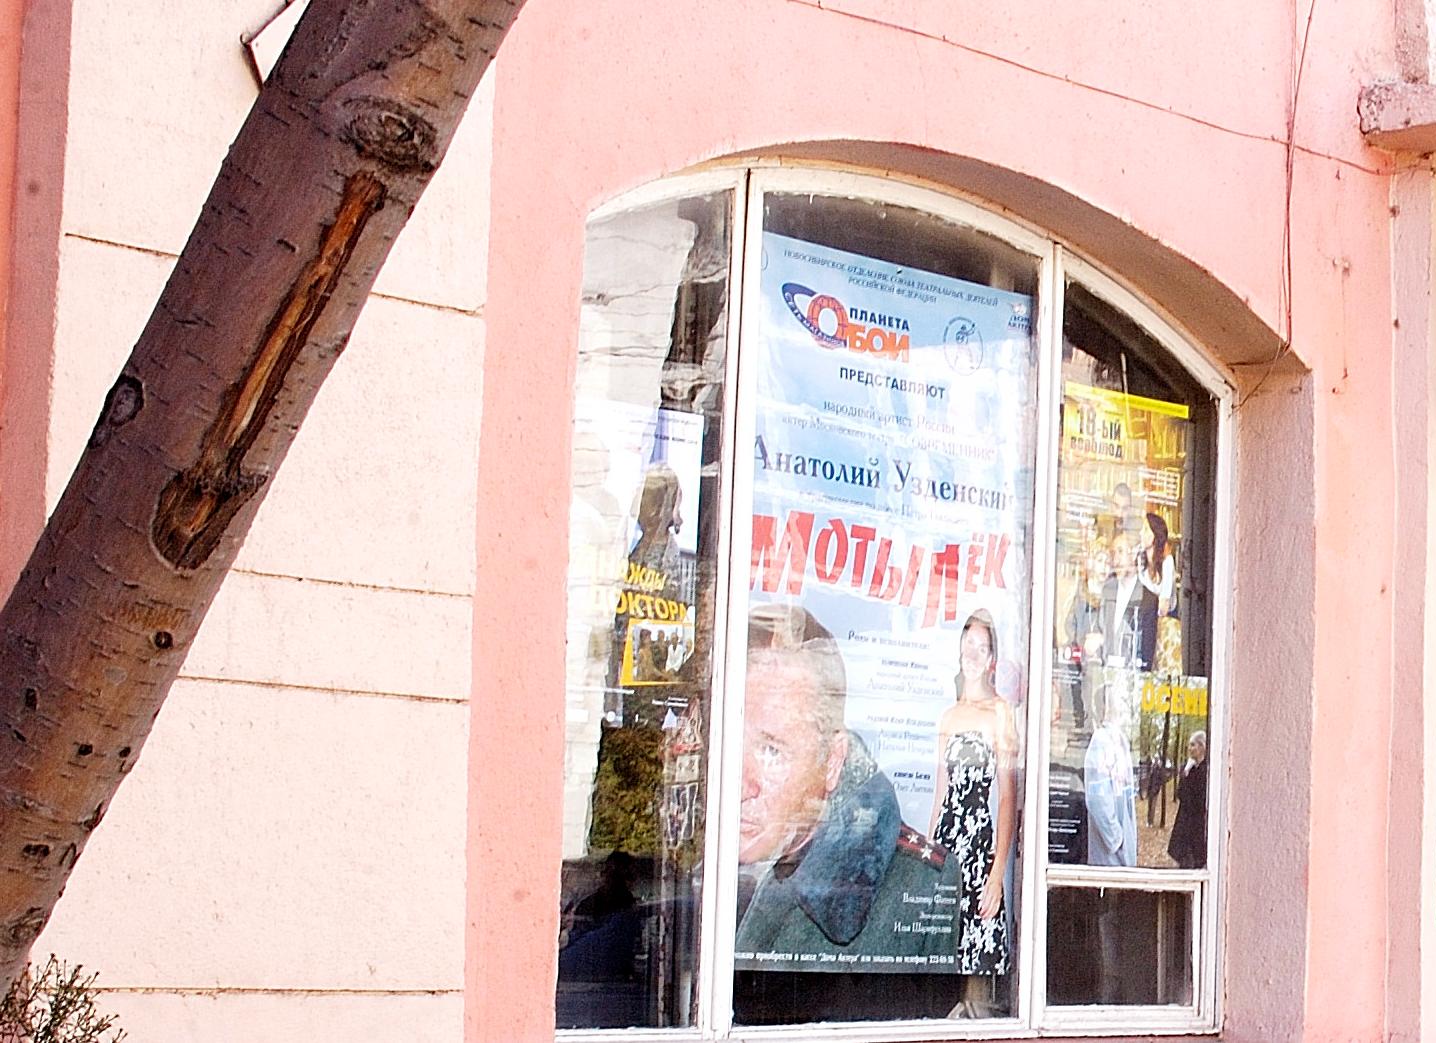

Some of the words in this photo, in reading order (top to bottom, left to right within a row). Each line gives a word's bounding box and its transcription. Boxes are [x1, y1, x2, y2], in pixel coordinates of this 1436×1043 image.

[849, 306, 910, 332] ПЛАНЕТА
[839, 366, 946, 400] ПРЕДСТАВЛЯЮТ
[755, 435, 881, 489] Анатолий
[891, 458, 1015, 512] Узденский
